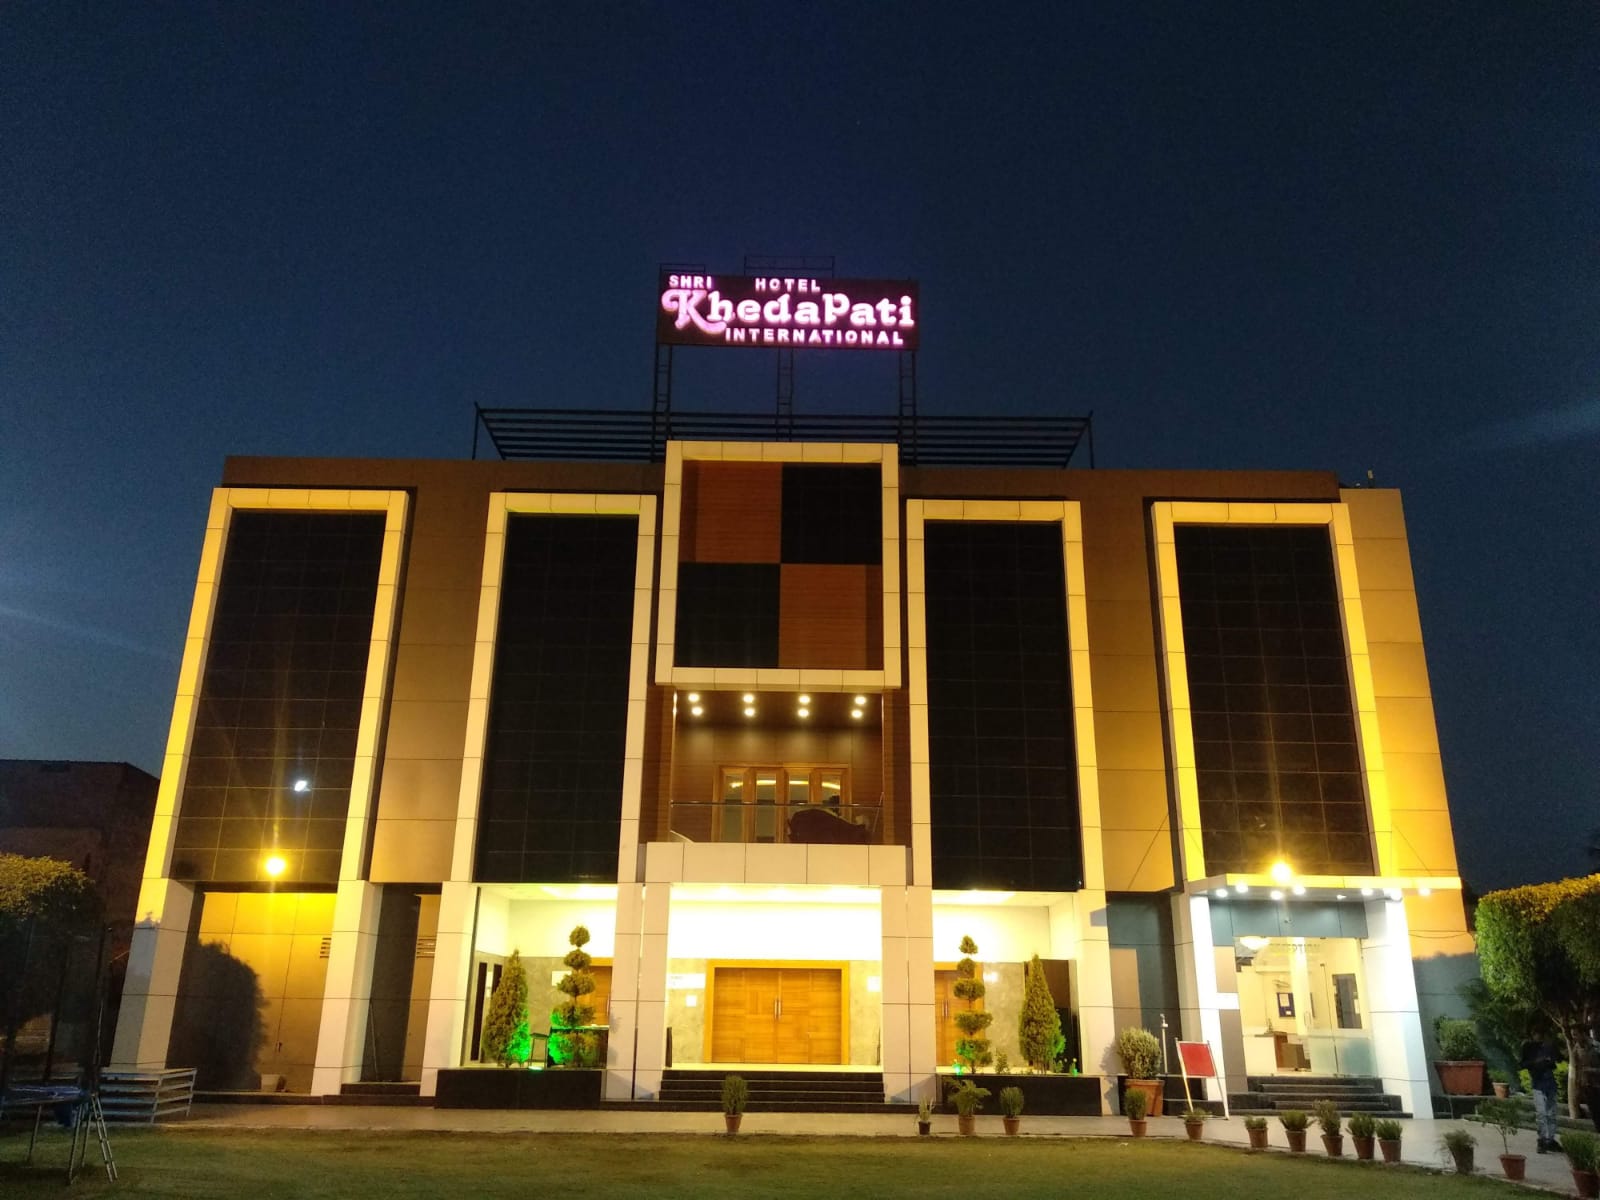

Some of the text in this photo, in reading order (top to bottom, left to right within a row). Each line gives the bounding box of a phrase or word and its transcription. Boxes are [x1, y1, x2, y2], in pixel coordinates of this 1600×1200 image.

[669, 275, 821, 292] SHRI HOTEL
[661, 288, 915, 334] KhedaPati
[725, 327, 904, 345] INTERNATIONAL
